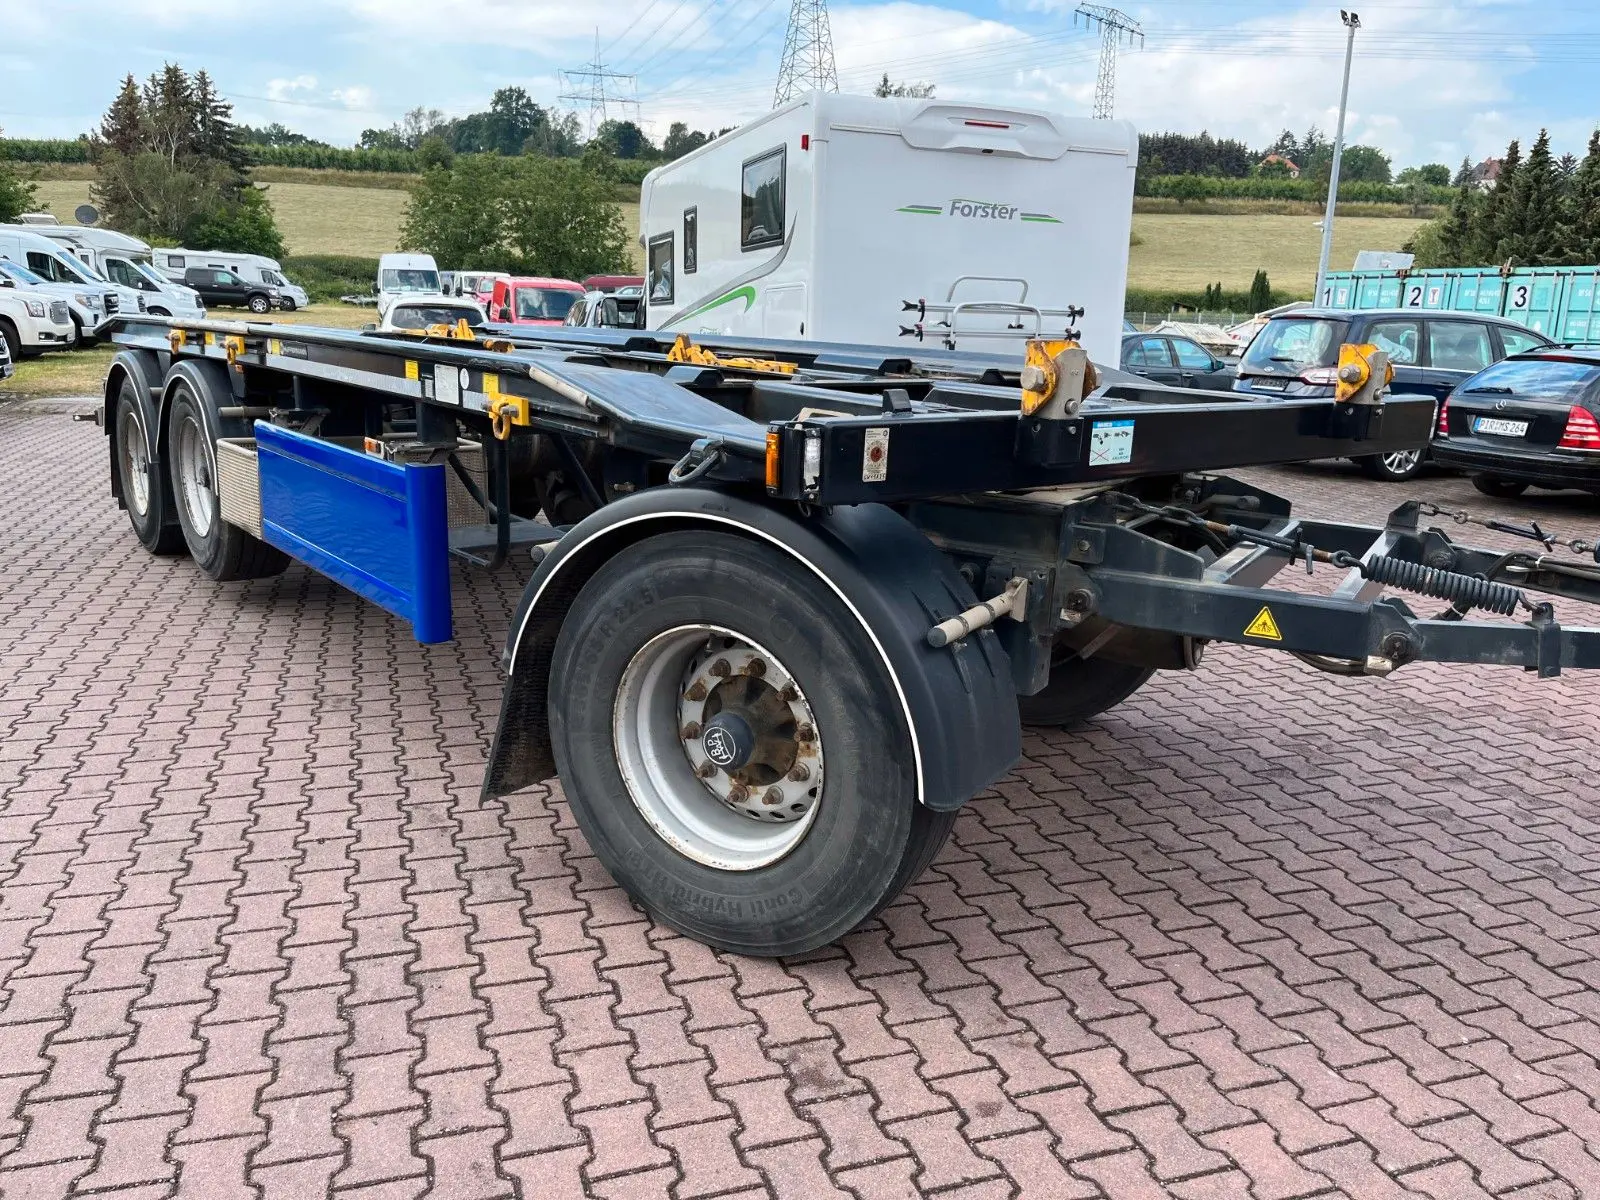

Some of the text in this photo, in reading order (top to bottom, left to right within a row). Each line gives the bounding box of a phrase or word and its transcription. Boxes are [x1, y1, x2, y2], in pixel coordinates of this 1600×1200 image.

[949, 200, 1018, 220] Forster
[1324, 287, 1331, 306] 1
[1410, 286, 1422, 307] 2
[1514, 285, 1528, 308] 3
[1510, 422, 1526, 433] 264
